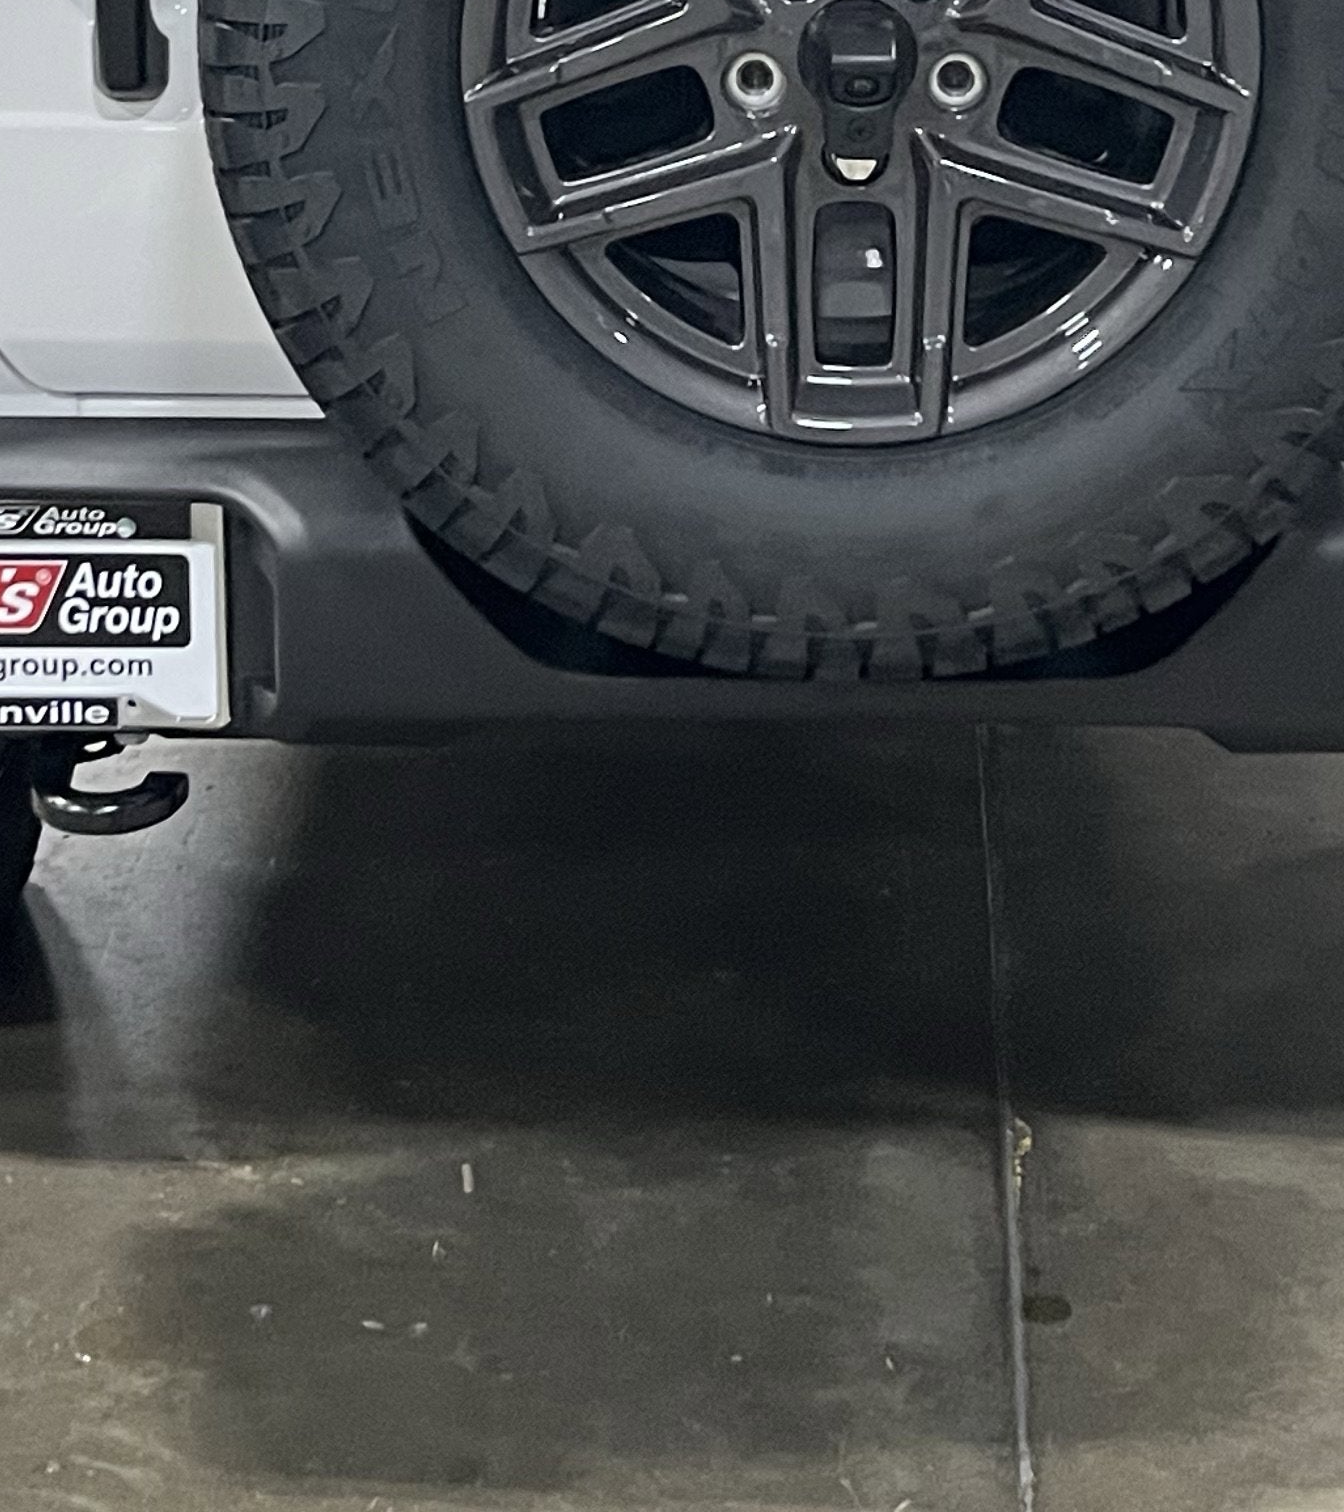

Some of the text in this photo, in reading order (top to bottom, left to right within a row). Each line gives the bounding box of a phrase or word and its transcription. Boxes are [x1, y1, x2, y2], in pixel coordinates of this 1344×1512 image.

[36, 506, 106, 522] Auto
[33, 519, 119, 538] Group
[65, 561, 163, 599] Auto
[58, 599, 180, 641] Group
